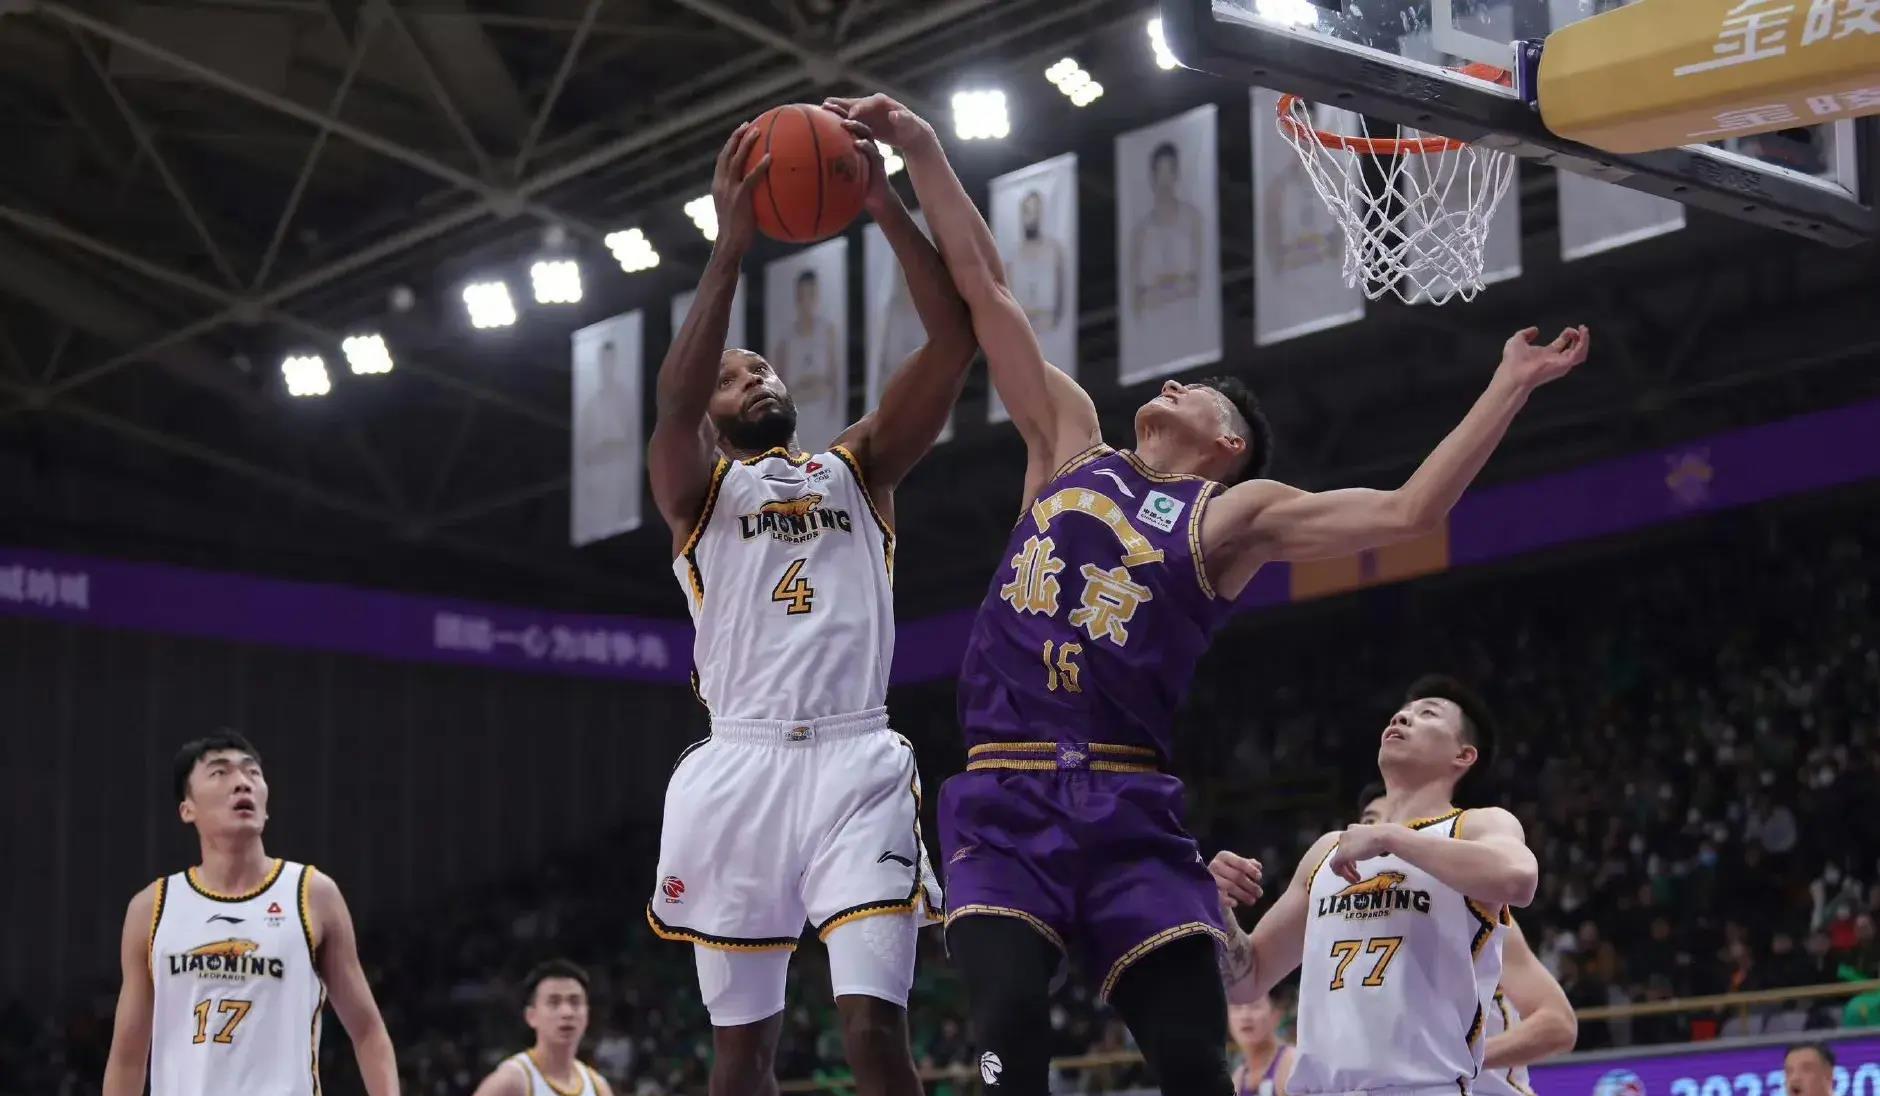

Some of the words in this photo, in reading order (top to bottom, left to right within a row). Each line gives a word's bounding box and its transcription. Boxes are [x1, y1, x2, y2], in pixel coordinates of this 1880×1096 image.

[738, 507, 852, 541] LIAONING
[772, 531, 819, 544] LEOPARDS
[771, 557, 815, 615] 4
[1000, 534, 1154, 648] 北京
[1042, 638, 1083, 694] 15
[1317, 889, 1431, 918] LIAONING
[1345, 909, 1390, 920] LEOPARDS
[168, 953, 284, 979] LIAONING
[1329, 936, 1404, 991] 77
[192, 998, 253, 1045] 17
